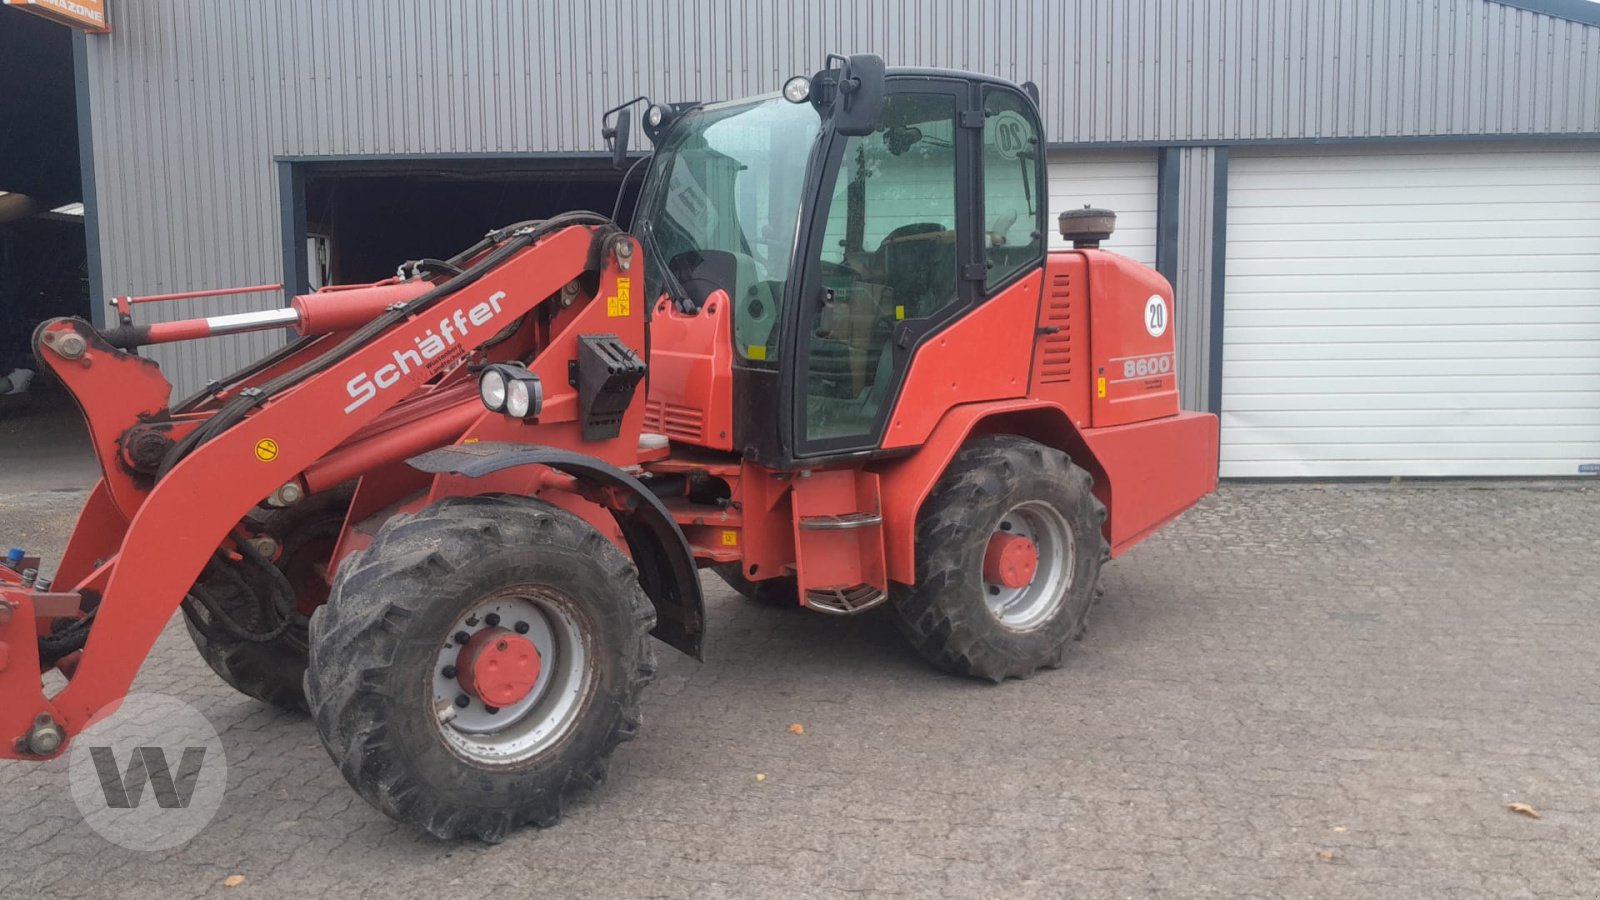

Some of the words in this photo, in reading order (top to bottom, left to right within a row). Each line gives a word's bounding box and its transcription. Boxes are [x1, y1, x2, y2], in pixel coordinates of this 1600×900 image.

[43, 0, 103, 21] MAZONE
[1149, 303, 1164, 329] 20
[344, 290, 506, 414] Schäffer
[1123, 355, 1170, 378] 8600
